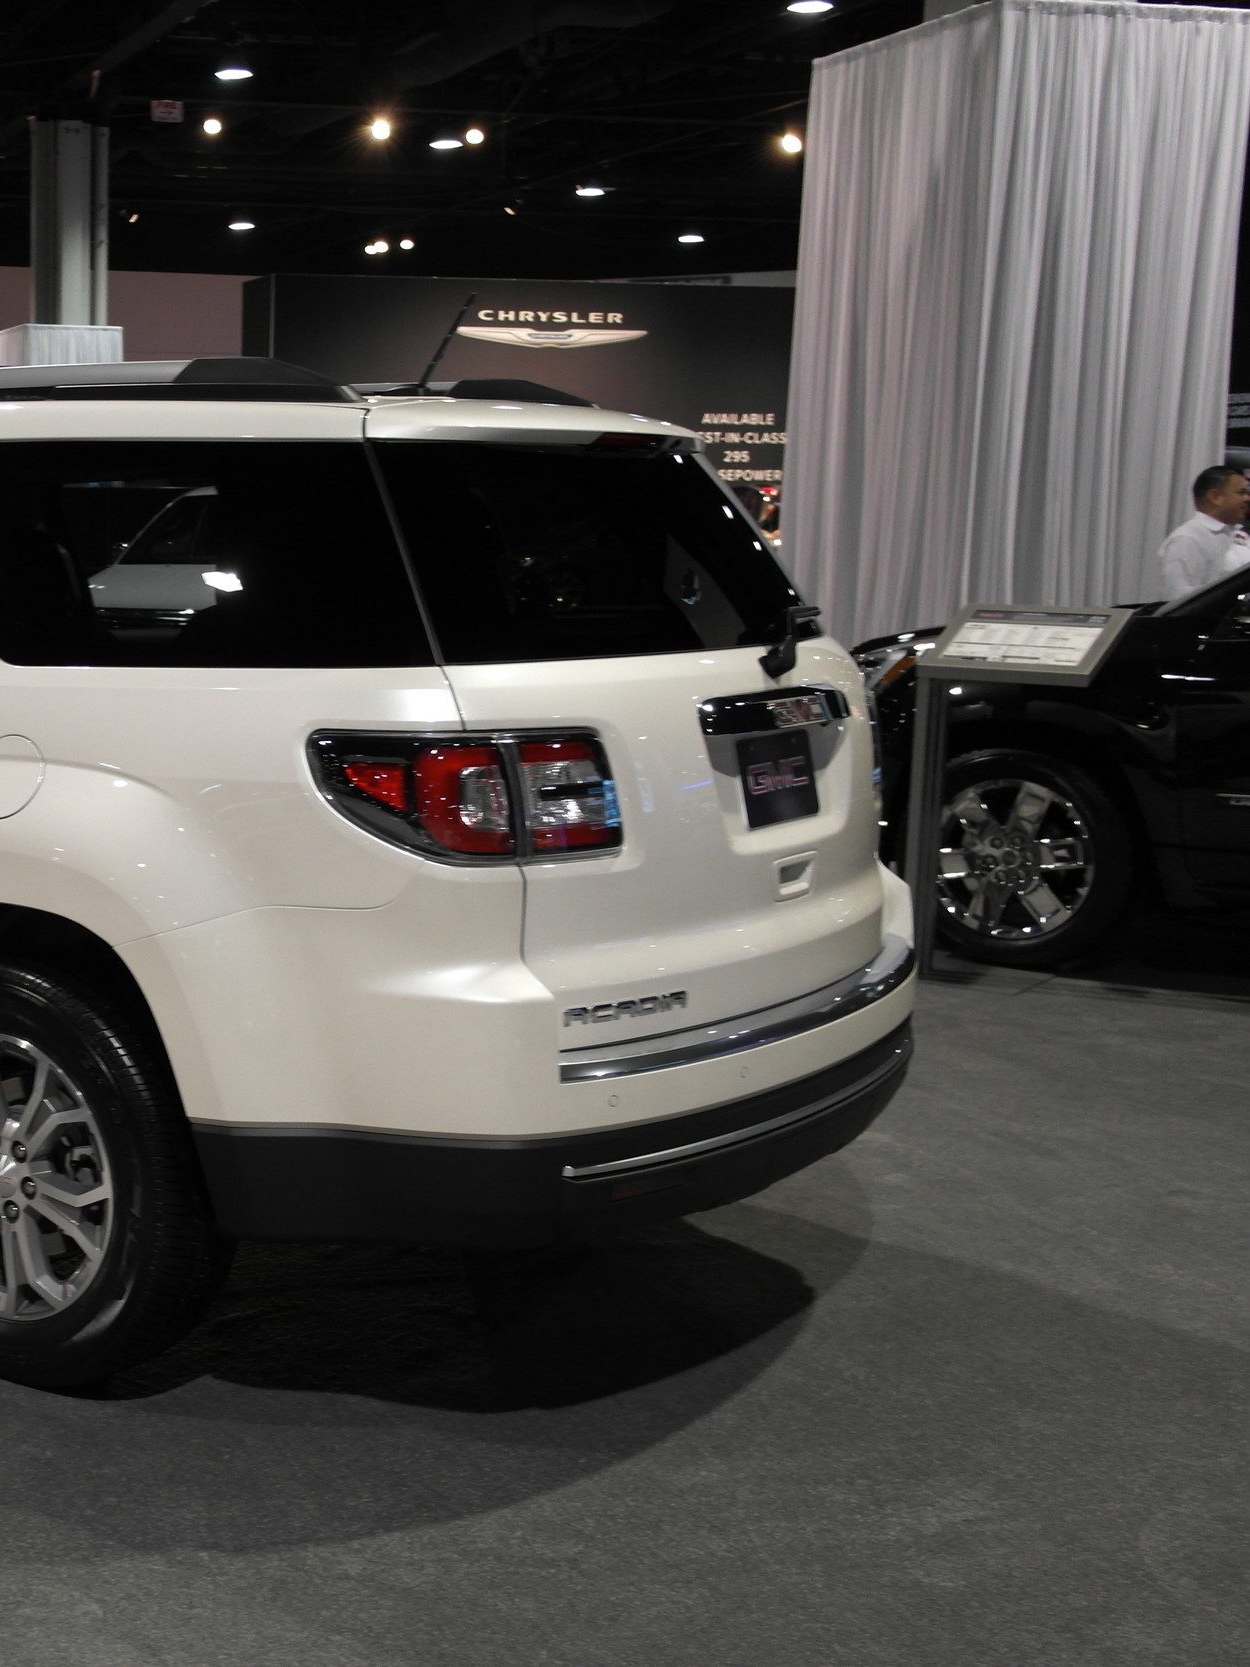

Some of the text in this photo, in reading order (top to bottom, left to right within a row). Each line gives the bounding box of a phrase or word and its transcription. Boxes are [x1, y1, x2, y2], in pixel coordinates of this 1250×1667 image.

[477, 309, 624, 324] CHRYSLER
[701, 413, 776, 426] AVAILABLE
[695, 431, 788, 444] ST-IN-CLASS
[722, 450, 751, 463] 295
[746, 756, 809, 795] GMC
[563, 990, 687, 1028] ACADIA
